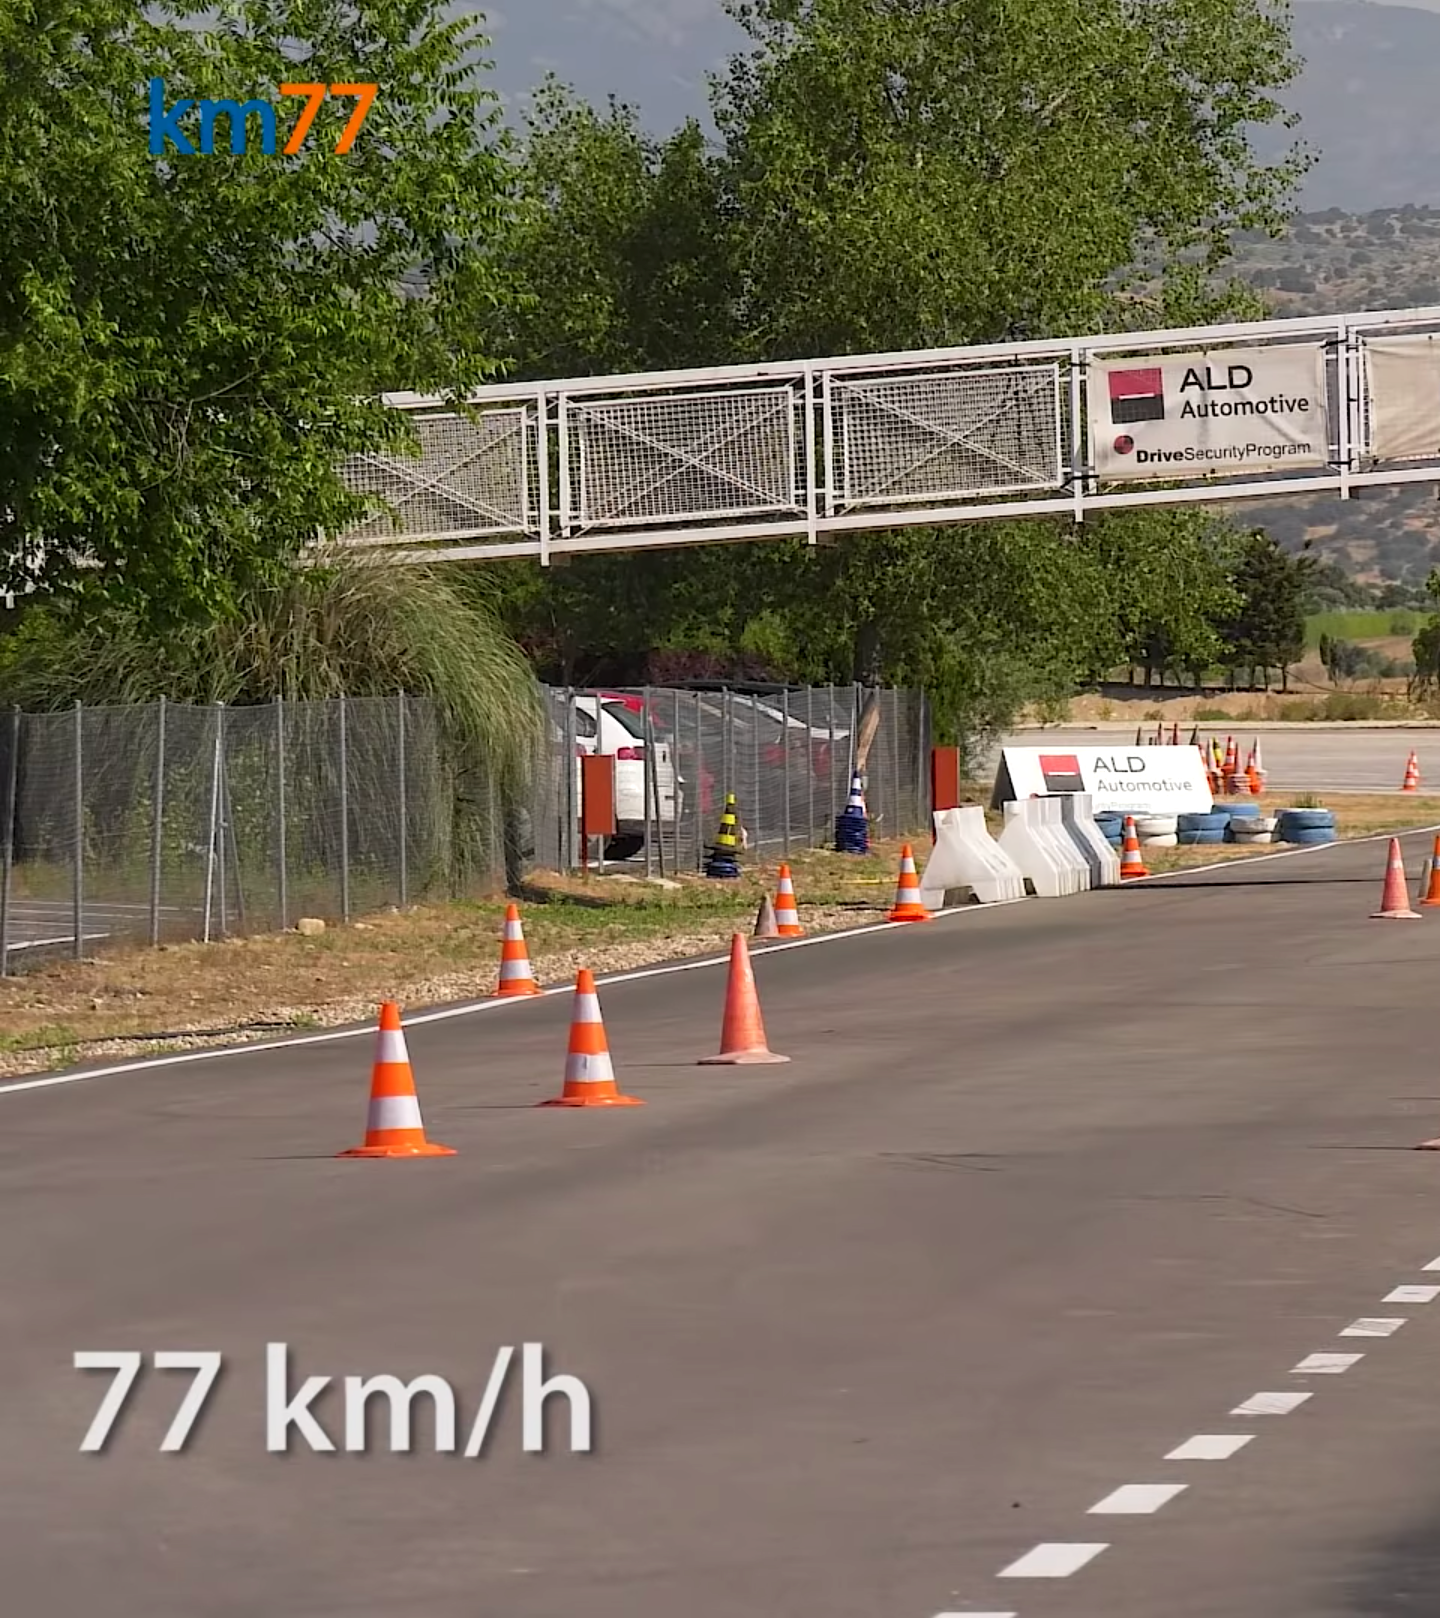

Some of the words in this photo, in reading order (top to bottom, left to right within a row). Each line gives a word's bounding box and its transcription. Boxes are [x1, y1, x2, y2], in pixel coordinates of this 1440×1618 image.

[1179, 364, 1253, 393] ALD
[1180, 393, 1309, 419] Automotive
[1136, 441, 1311, 464] DriveSecurityProgram
[1093, 756, 1146, 773] ALD
[1097, 779, 1193, 792] Automotive
